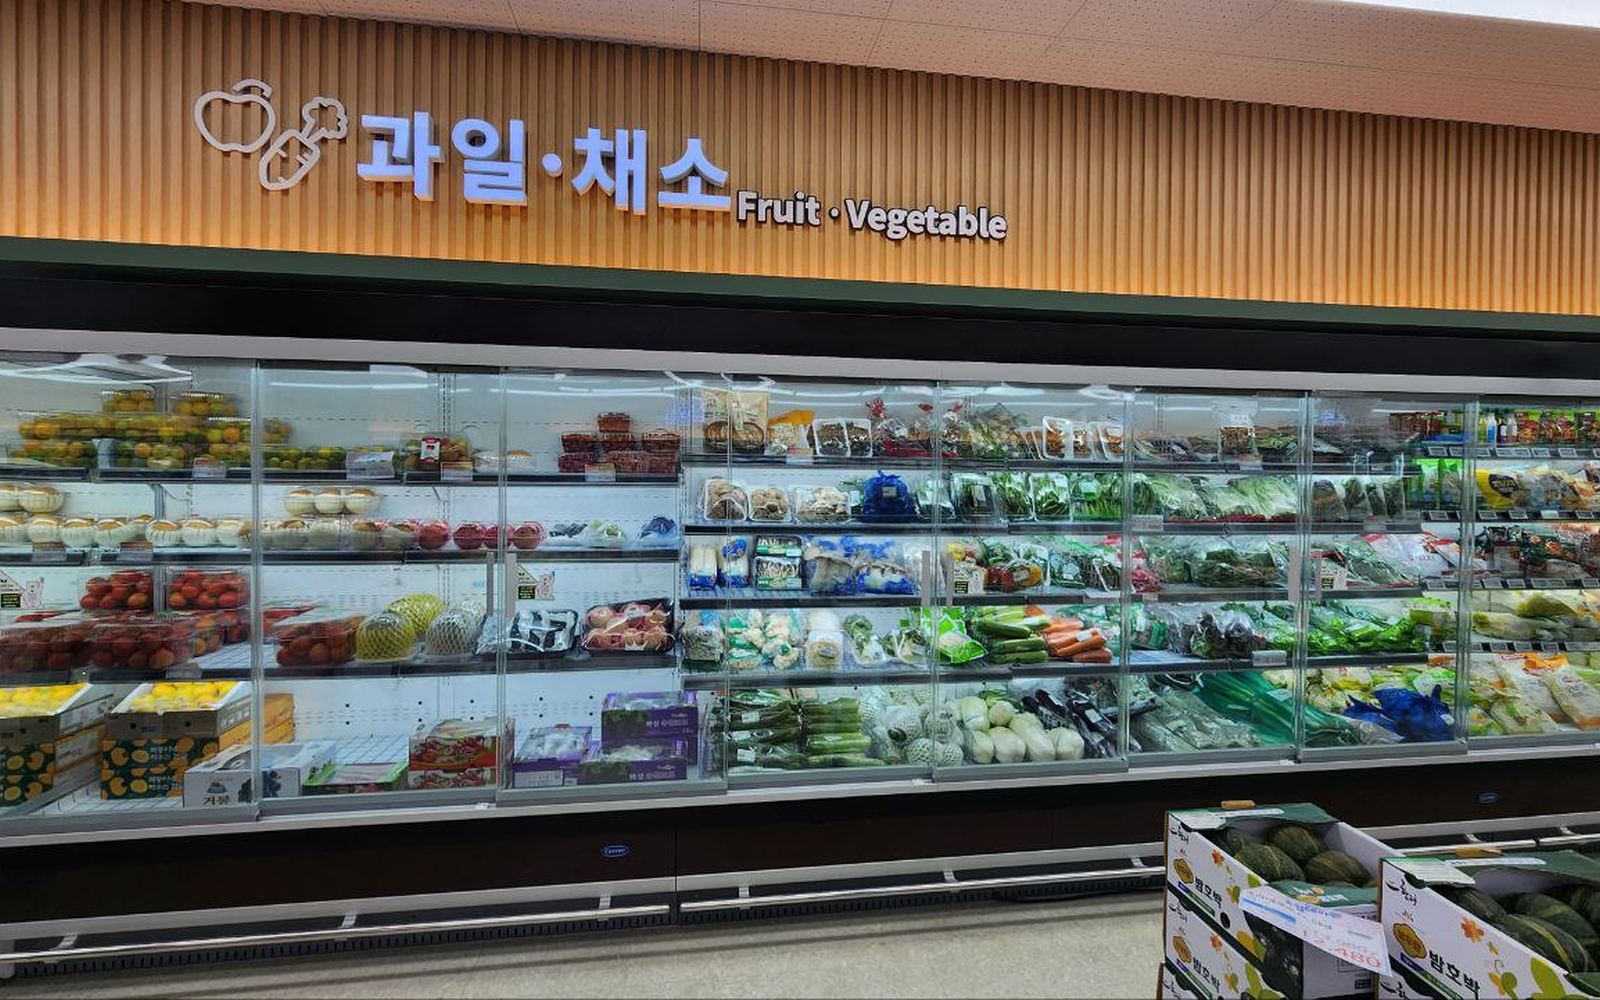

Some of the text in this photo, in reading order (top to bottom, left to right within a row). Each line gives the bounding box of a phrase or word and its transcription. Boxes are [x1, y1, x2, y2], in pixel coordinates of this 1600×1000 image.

[357, 111, 731, 216] 과일·채소
[737, 190, 821, 227] Fruit
[844, 198, 1009, 241] Vegetable
[1195, 876, 1222, 908] 밤호박
[1429, 950, 1480, 1000] 밤호박
